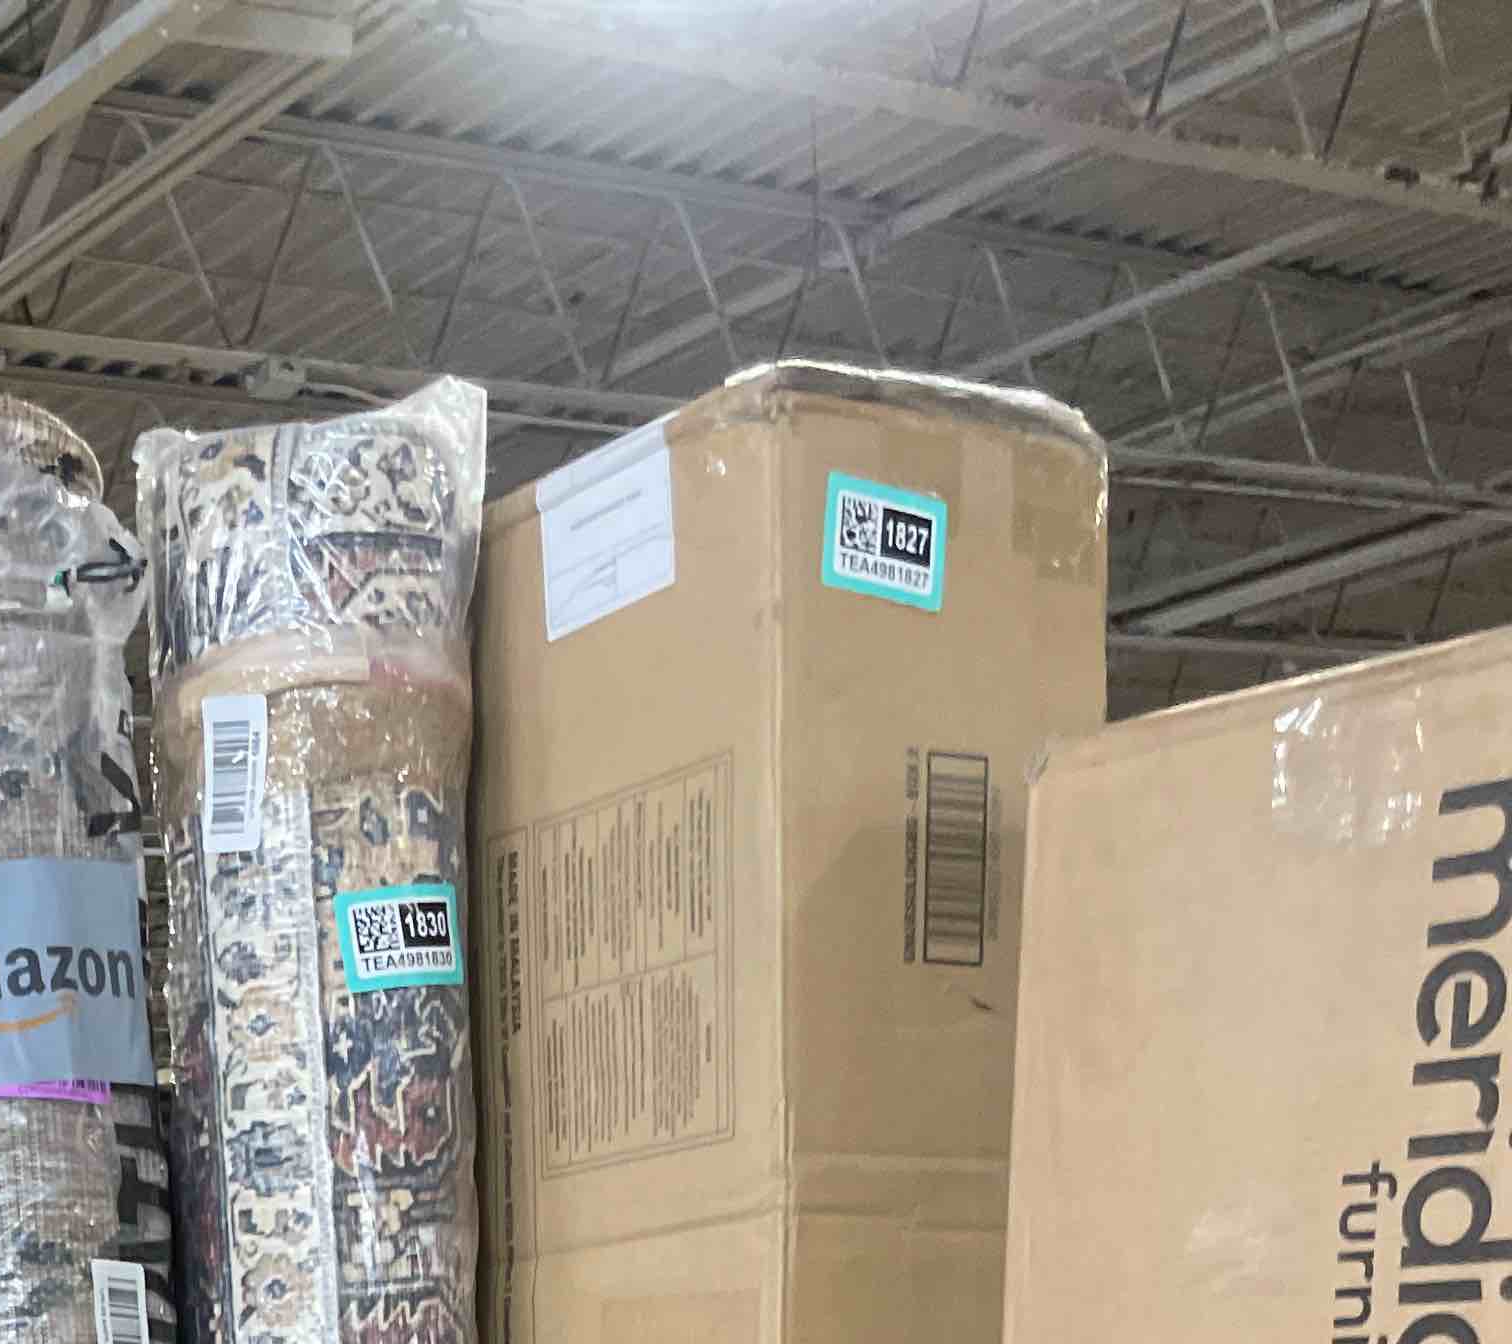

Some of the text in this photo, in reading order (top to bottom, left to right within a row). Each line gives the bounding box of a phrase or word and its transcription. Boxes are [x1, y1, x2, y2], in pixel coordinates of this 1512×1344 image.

[886, 518, 929, 555] 1827
[839, 552, 930, 589] TEA4981827
[404, 911, 448, 938] 1830
[360, 950, 453, 973] TEA4981830
